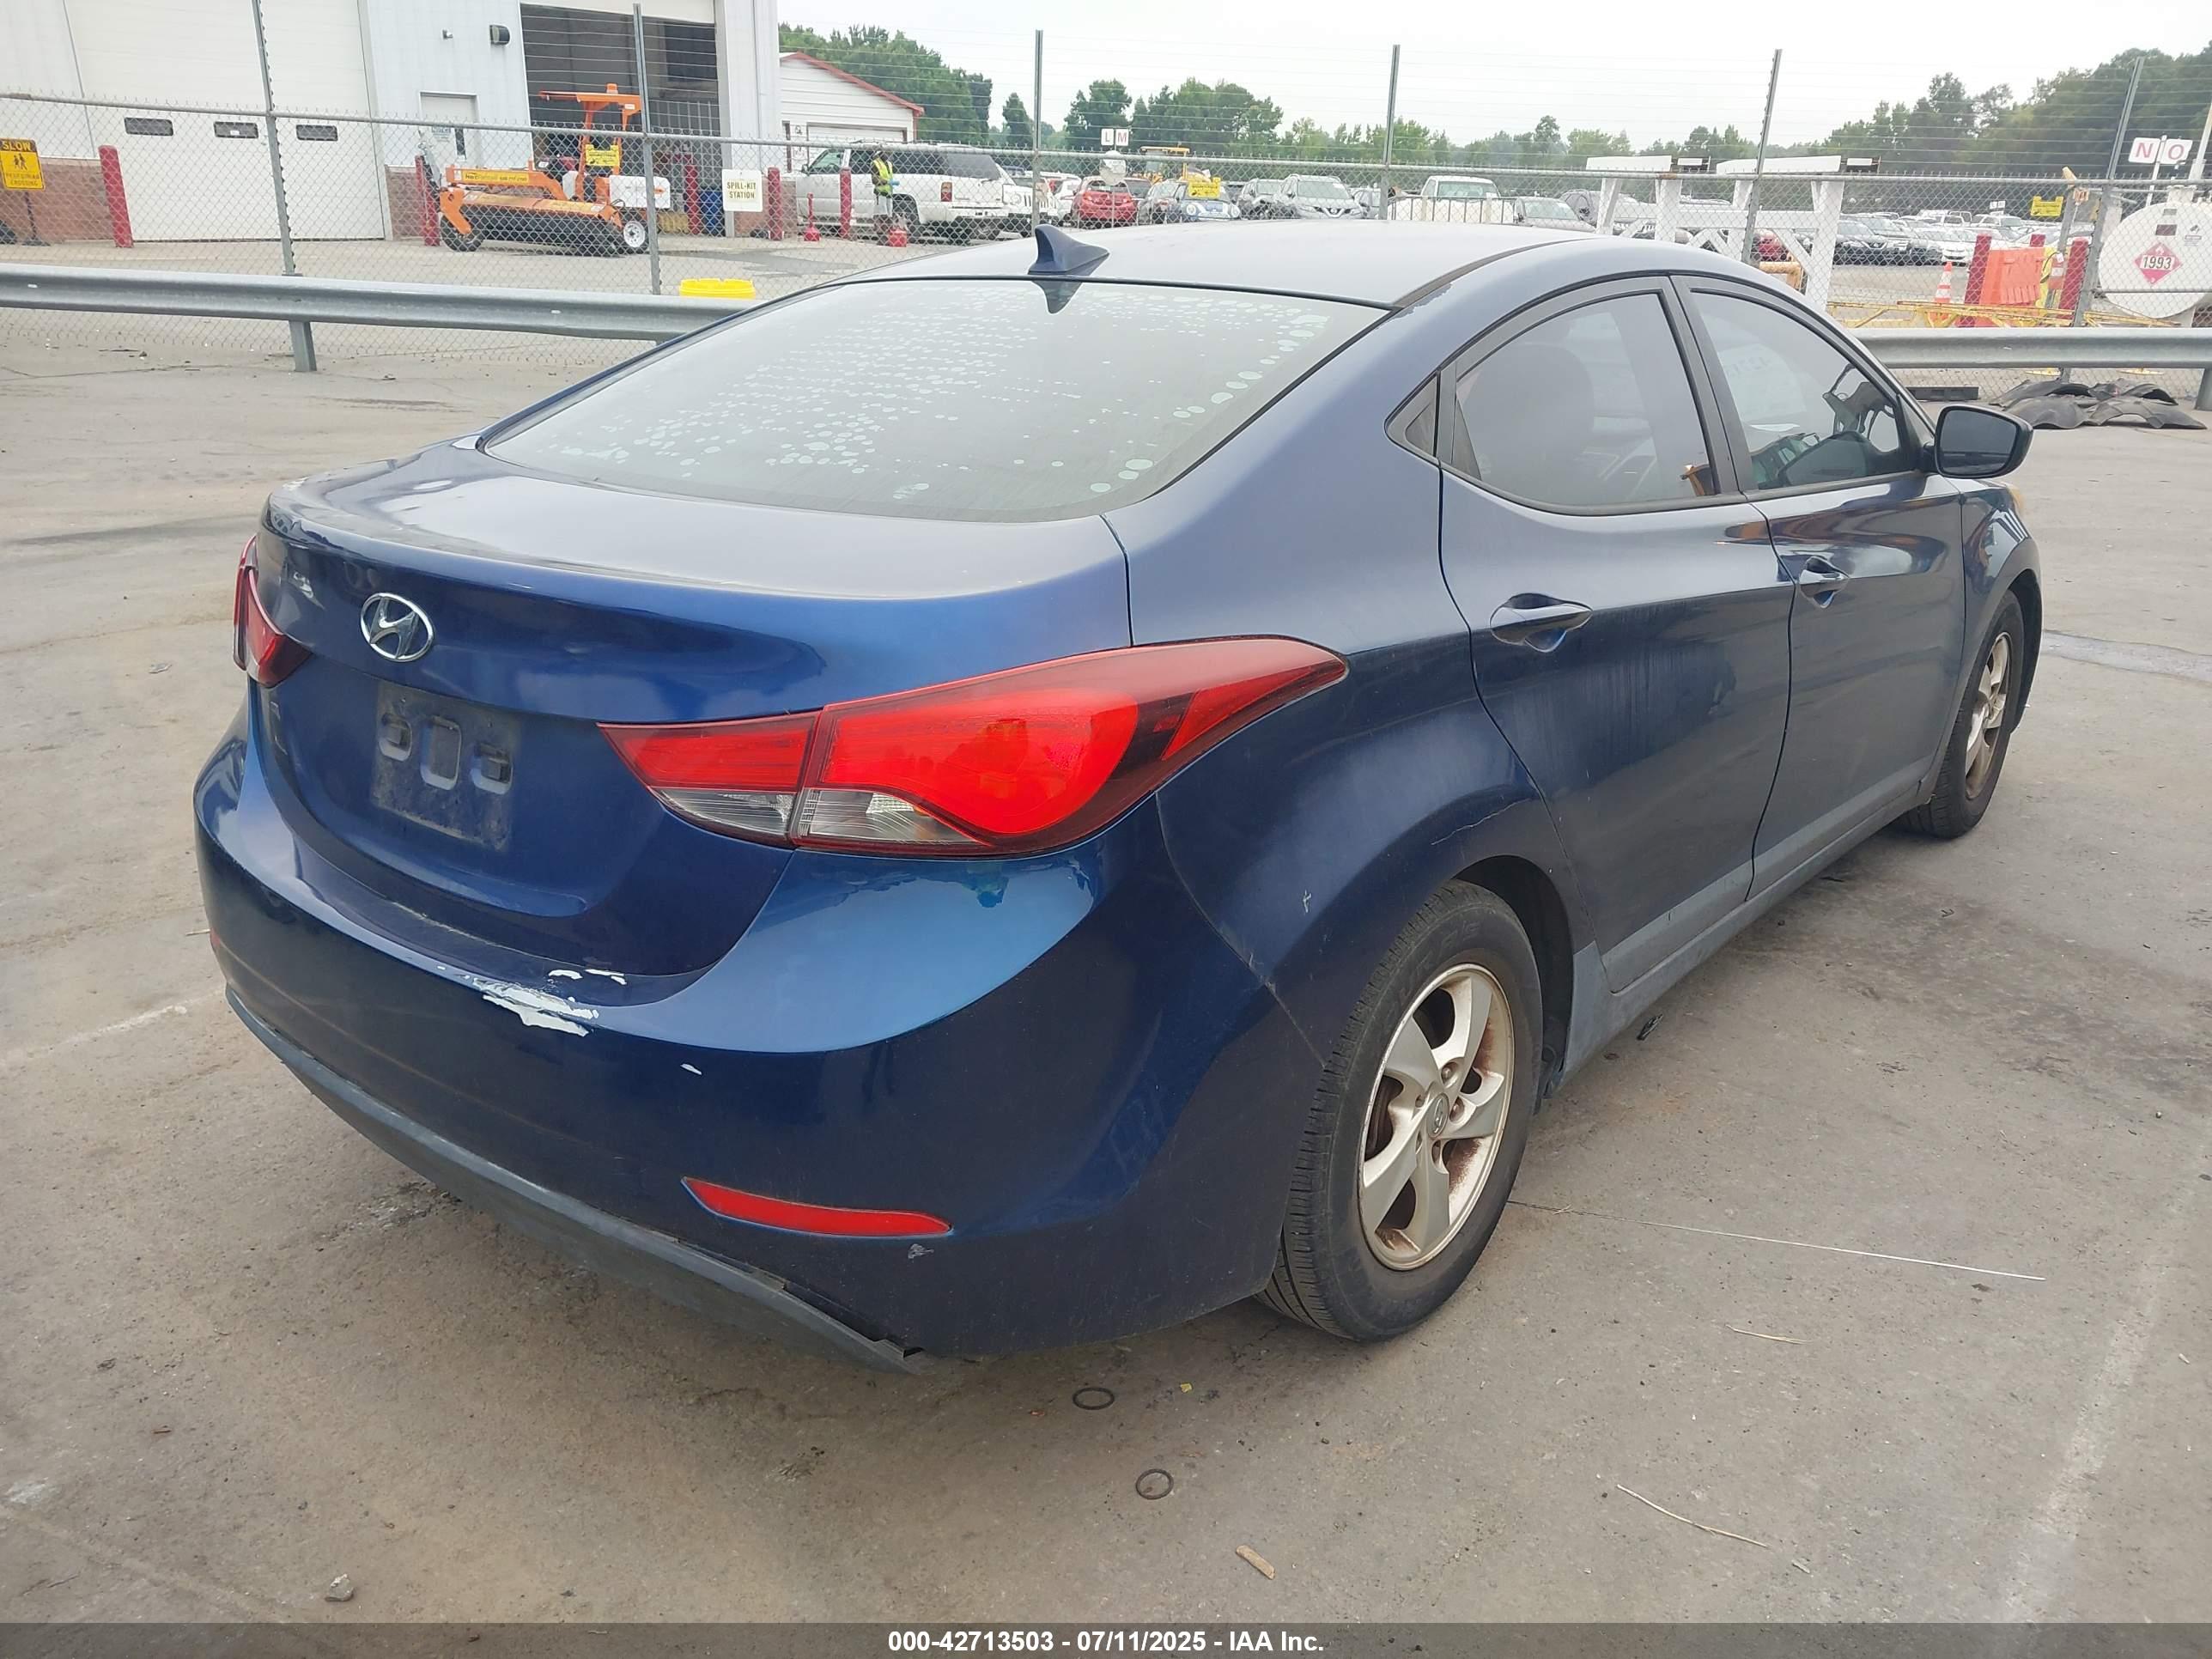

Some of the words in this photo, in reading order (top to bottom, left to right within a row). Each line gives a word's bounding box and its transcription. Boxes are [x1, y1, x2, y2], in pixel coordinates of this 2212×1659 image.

[1104, 131, 1111, 143] L
[1117, 131, 1127, 143] M
[2, 140, 32, 151] SLOW
[2135, 142, 2154, 158] N
[2167, 144, 2185, 161] O
[726, 181, 757, 190] SPILL-KIT
[729, 191, 755, 199] STATION
[2142, 256, 2172, 270] 1993
